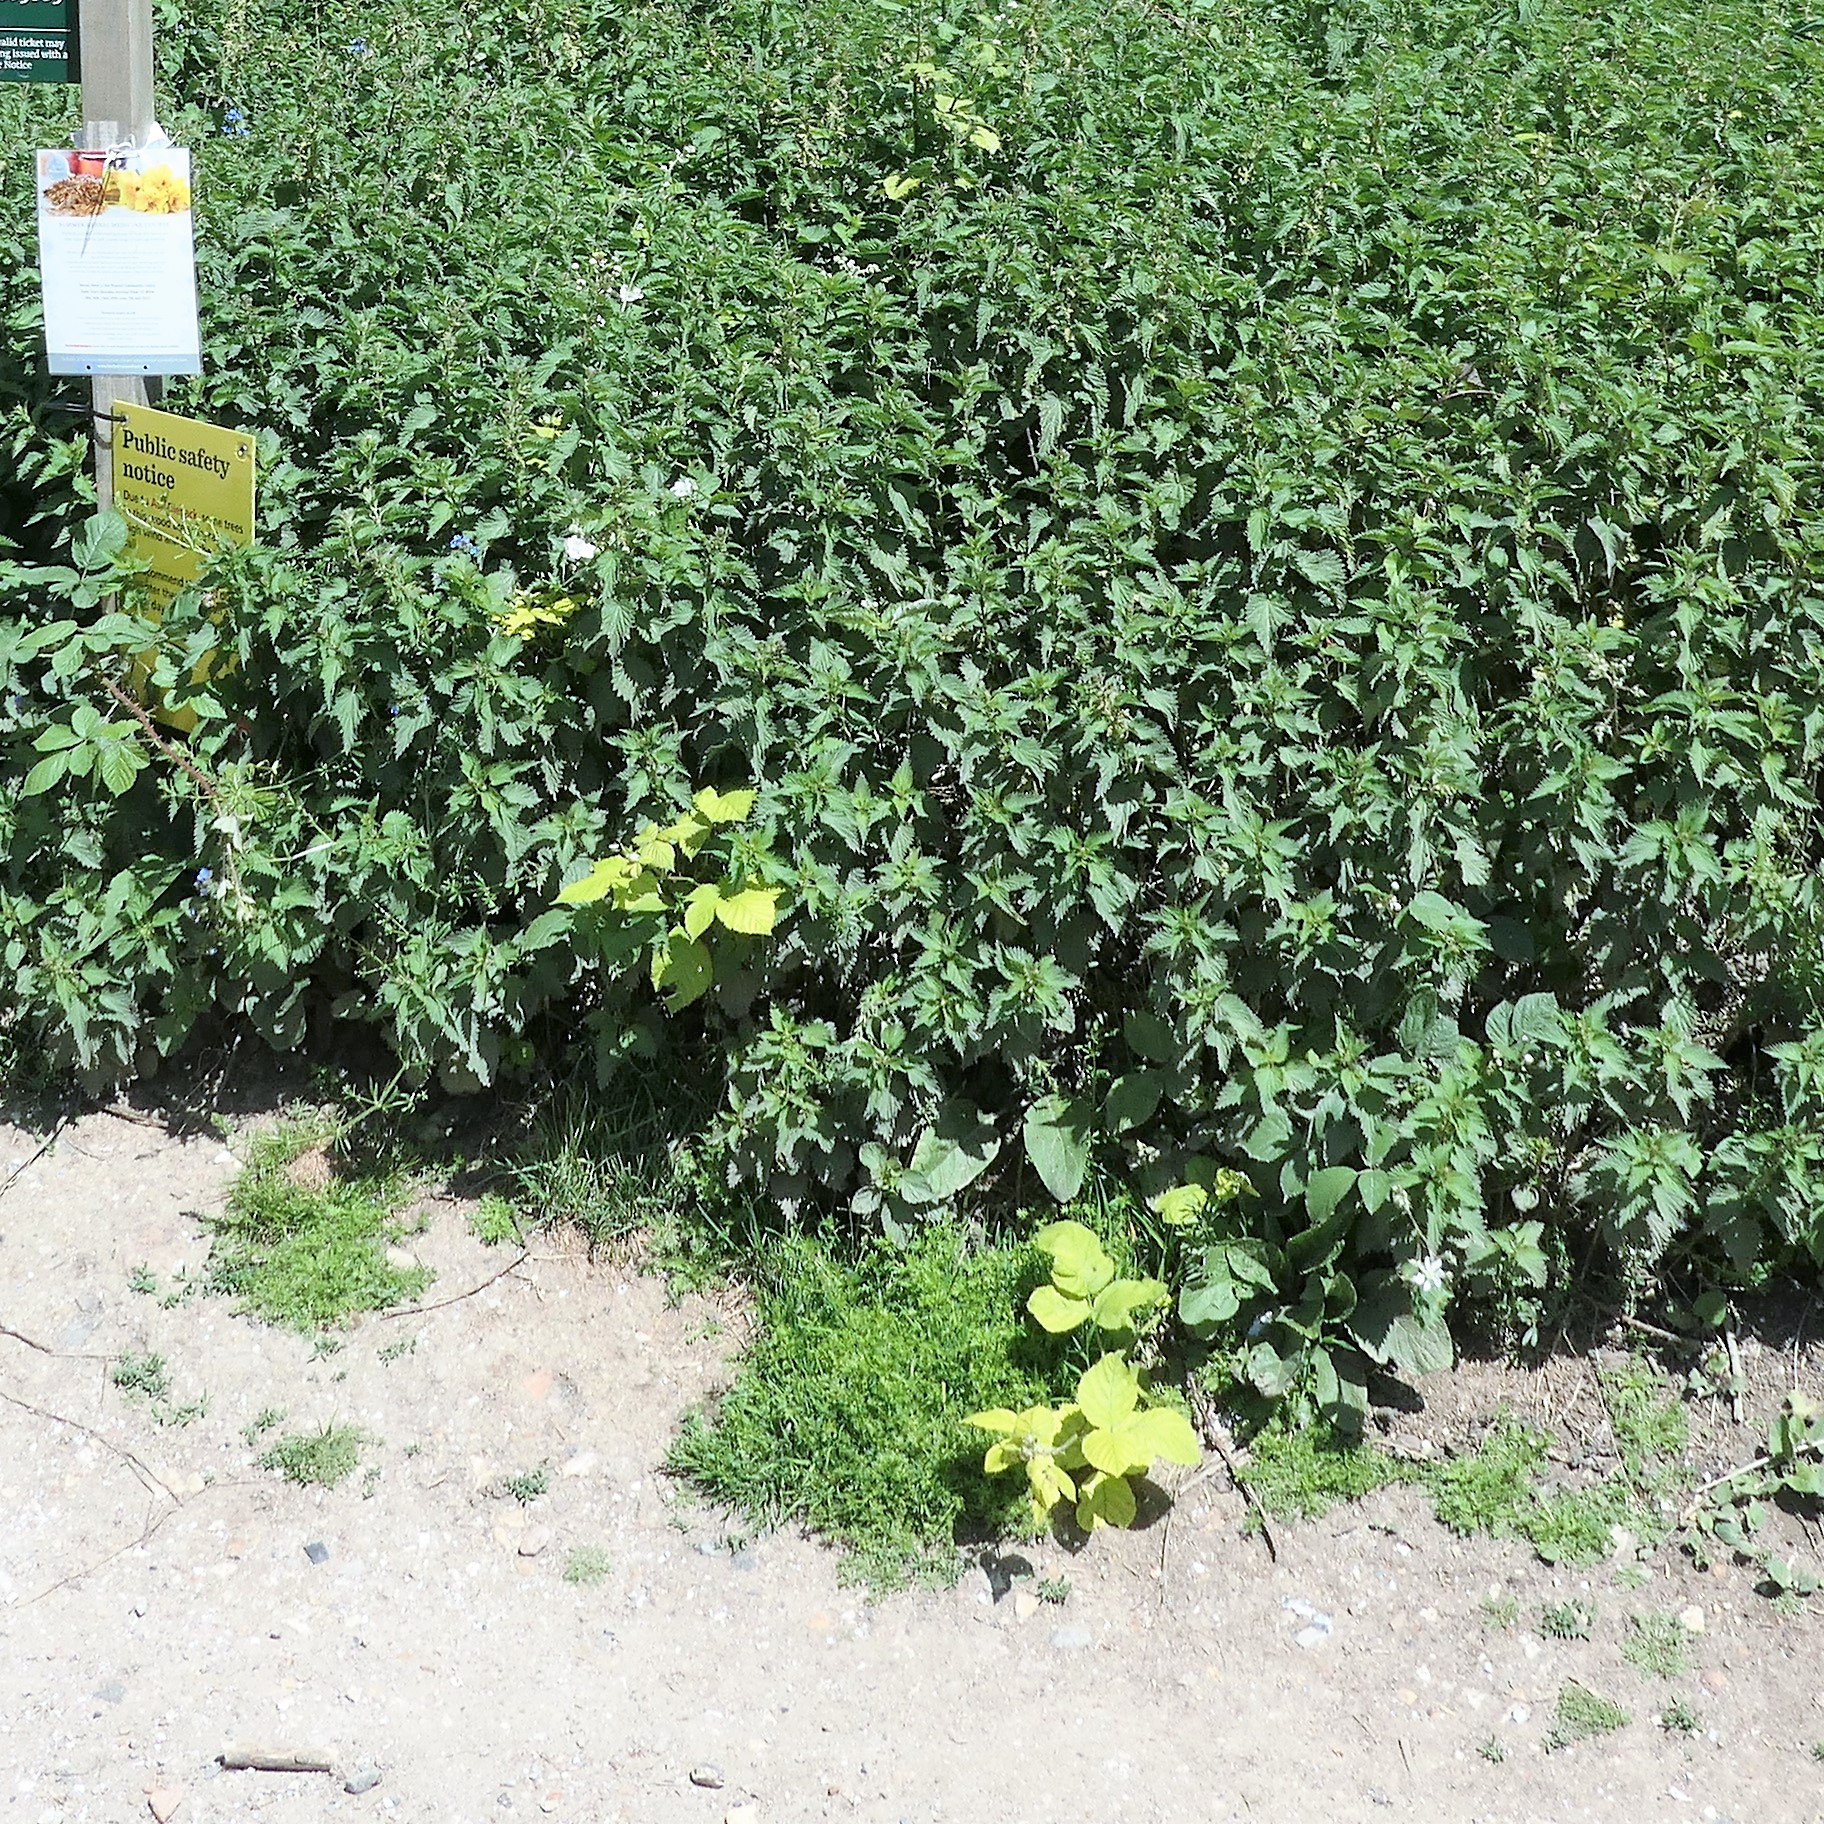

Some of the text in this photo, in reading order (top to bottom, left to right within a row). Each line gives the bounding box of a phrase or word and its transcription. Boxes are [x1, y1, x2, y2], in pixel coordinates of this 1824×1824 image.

[19, 38, 44, 47] ticket
[45, 40, 65, 50] may
[12, 49, 40, 58] issued
[40, 49, 62, 59] with
[62, 51, 69, 59] a
[3, 60, 33, 70] Notice
[122, 429, 231, 480] Public safety
[122, 462, 175, 490] notice
